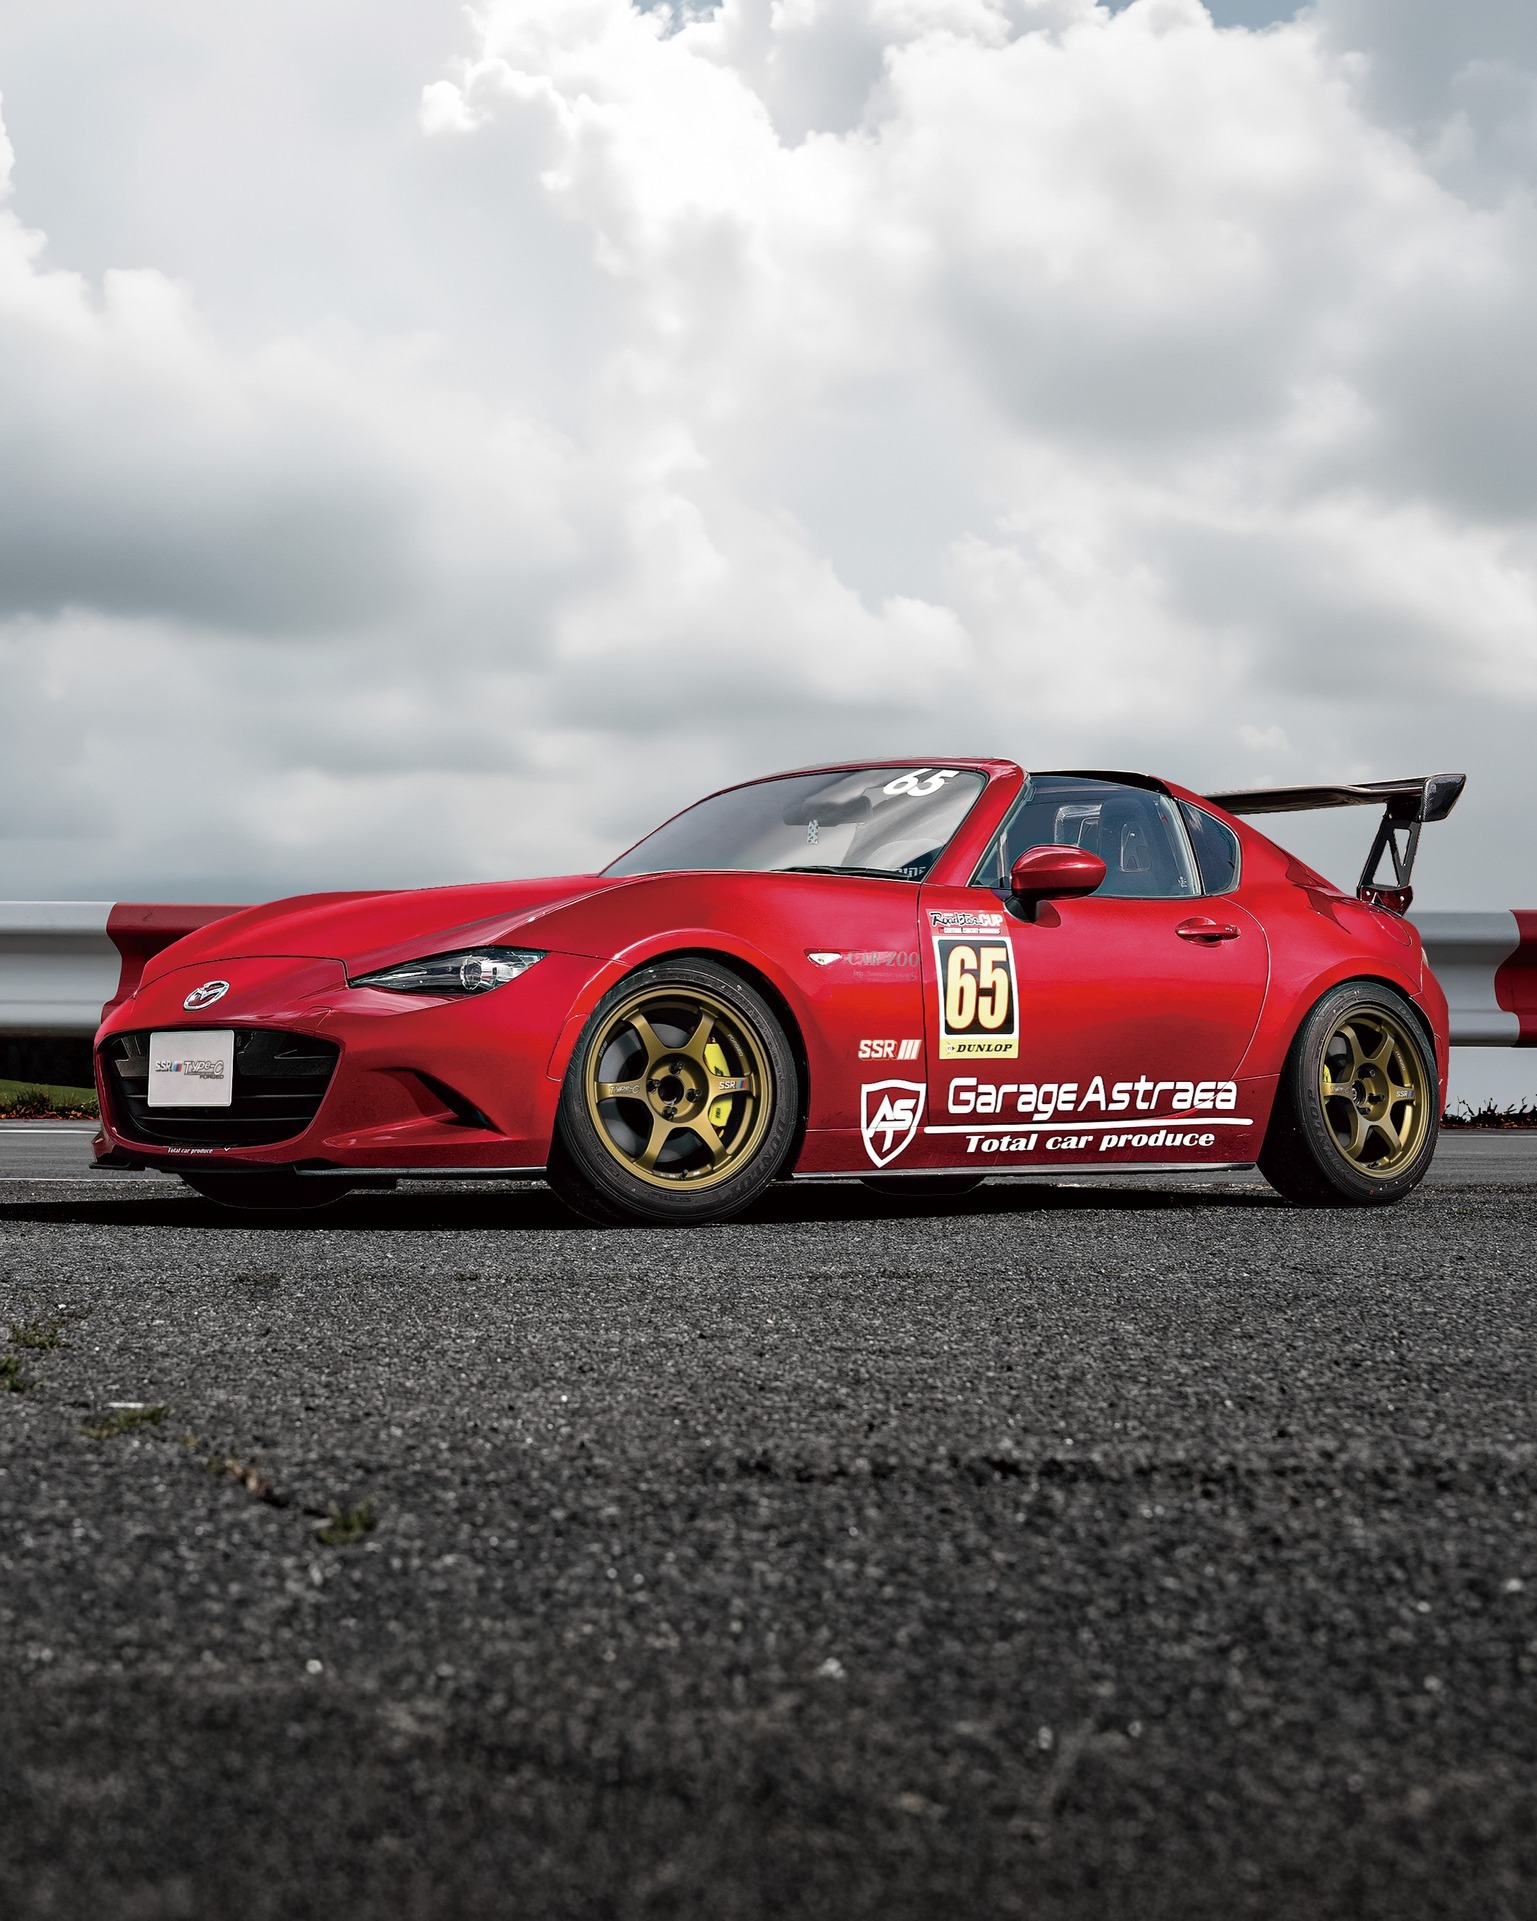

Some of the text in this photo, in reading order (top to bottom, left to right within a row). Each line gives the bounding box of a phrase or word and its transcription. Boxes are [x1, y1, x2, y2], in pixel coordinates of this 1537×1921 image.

[883, 768, 960, 797] 65
[978, 912, 1004, 927] CUP
[848, 950, 920, 967] CAR ZOO
[946, 944, 1009, 1030] 65
[858, 1039, 896, 1060] SSR
[956, 1043, 1013, 1053] DUNLOP
[155, 1060, 173, 1072] SSR
[719, 1081, 736, 1090] SSR
[965, 1129, 1215, 1153] Total car produce
